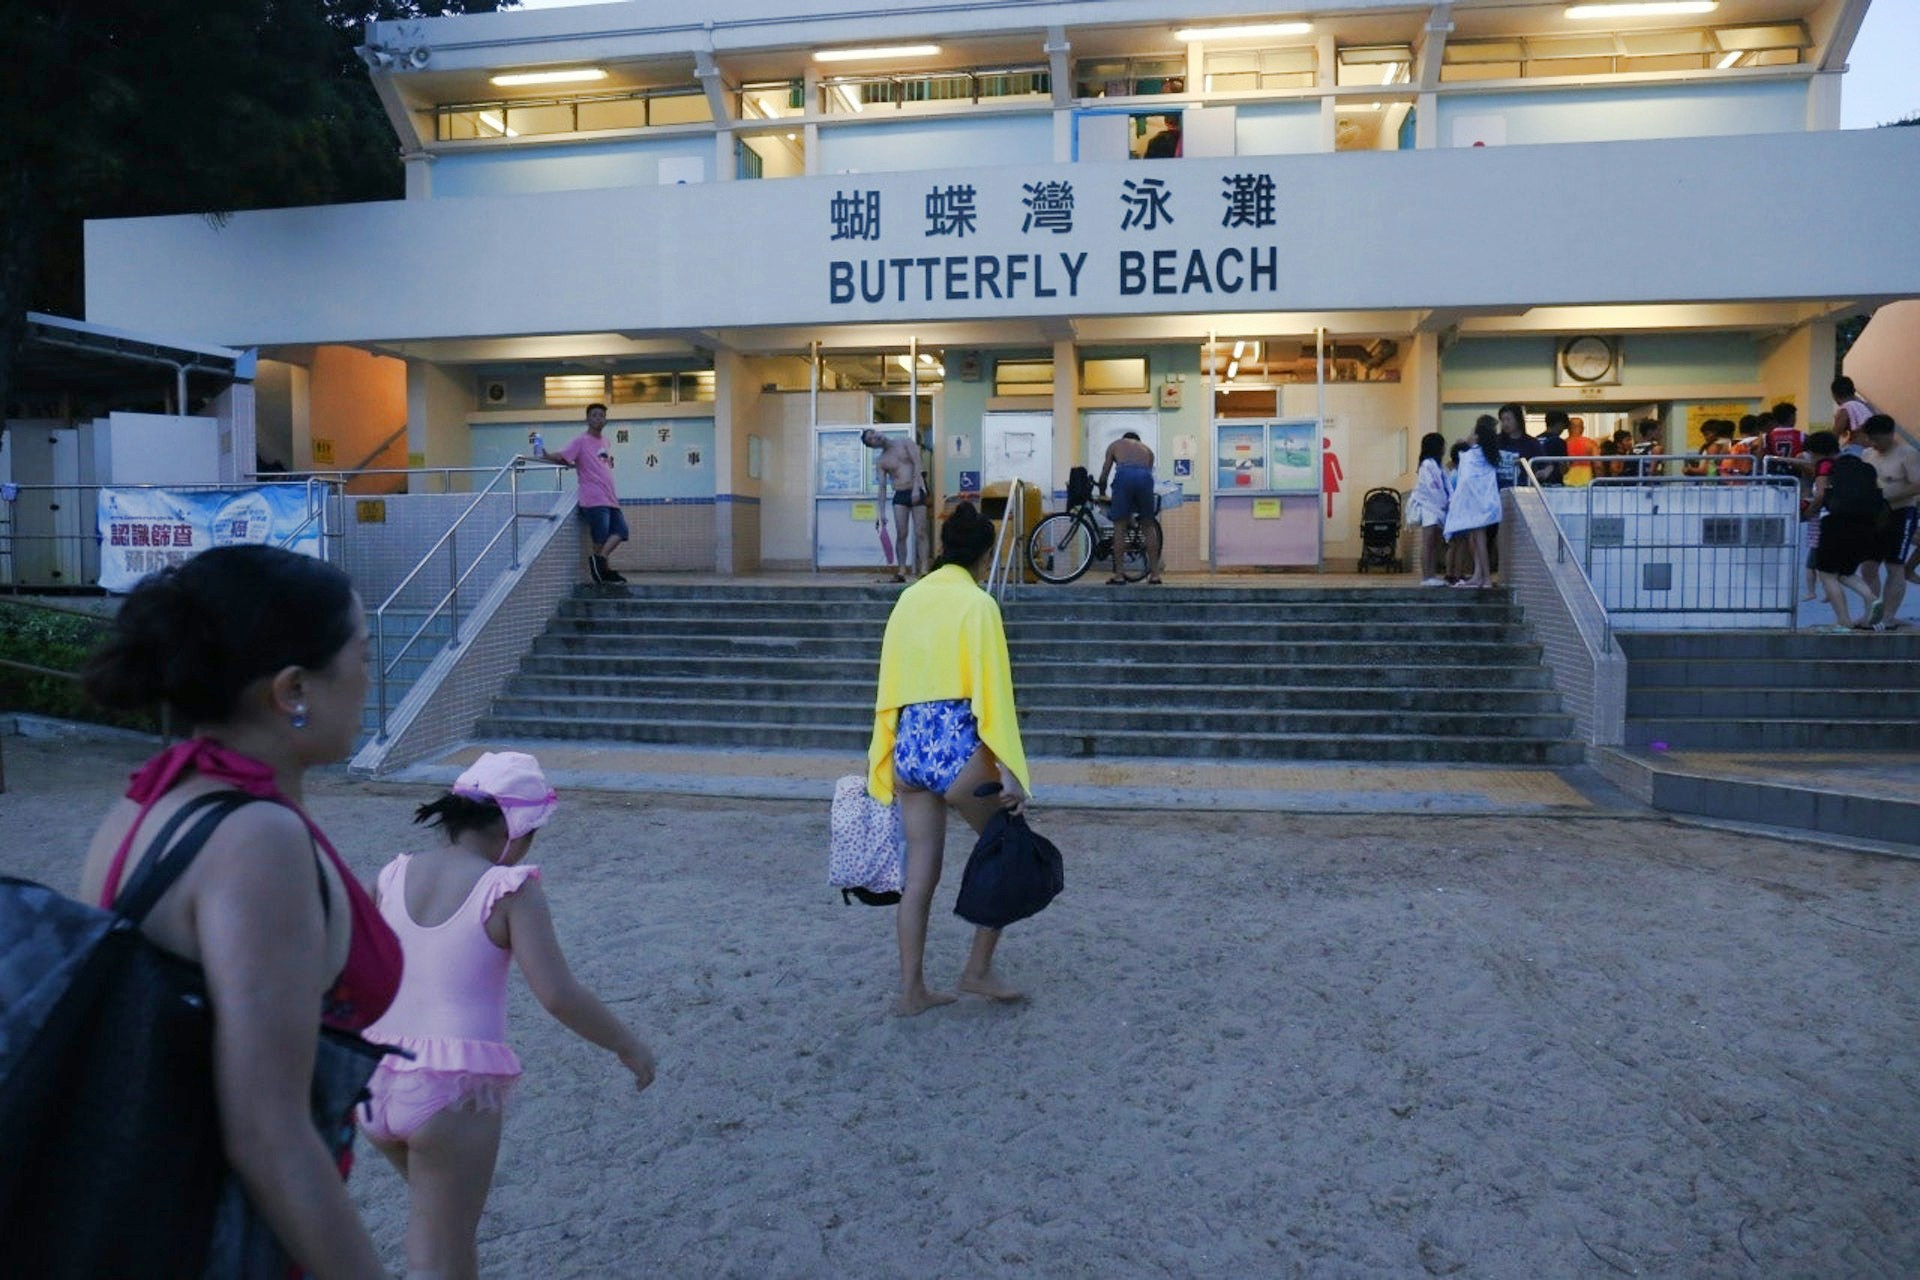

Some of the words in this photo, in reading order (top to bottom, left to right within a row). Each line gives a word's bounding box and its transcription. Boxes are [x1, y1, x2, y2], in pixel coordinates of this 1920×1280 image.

[830, 173, 1277, 241] 蝴蝶灣泳灘
[830, 252, 1088, 304] BUTTERFLY
[1120, 246, 1277, 295] BEACH
[110, 522, 193, 548] 認識篩查
